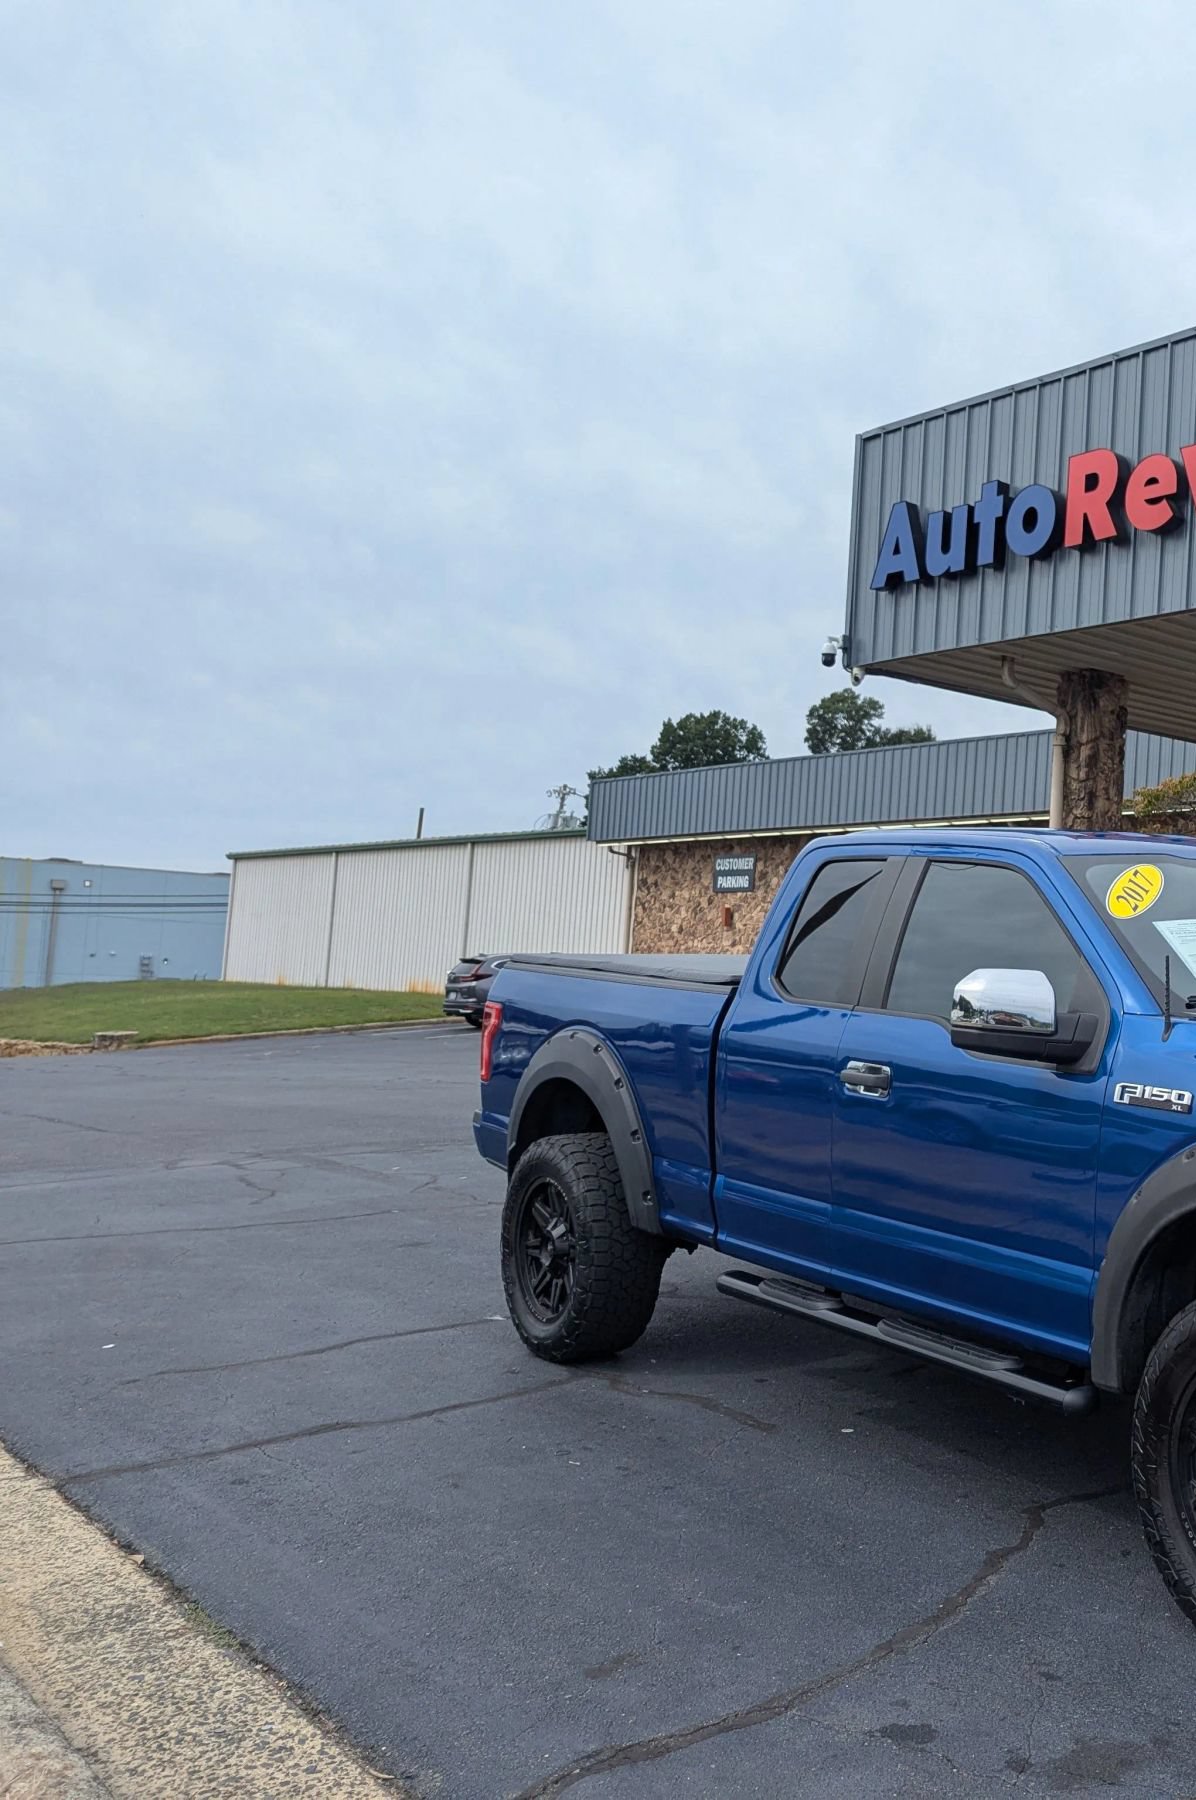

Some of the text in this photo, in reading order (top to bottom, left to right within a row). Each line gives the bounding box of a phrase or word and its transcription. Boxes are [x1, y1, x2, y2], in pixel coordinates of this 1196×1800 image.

[716, 857, 754, 871] CUSTOMER
[717, 875, 749, 889] PARKING
[1116, 869, 1154, 913] 2017
[1171, 1104, 1183, 1112] XL
